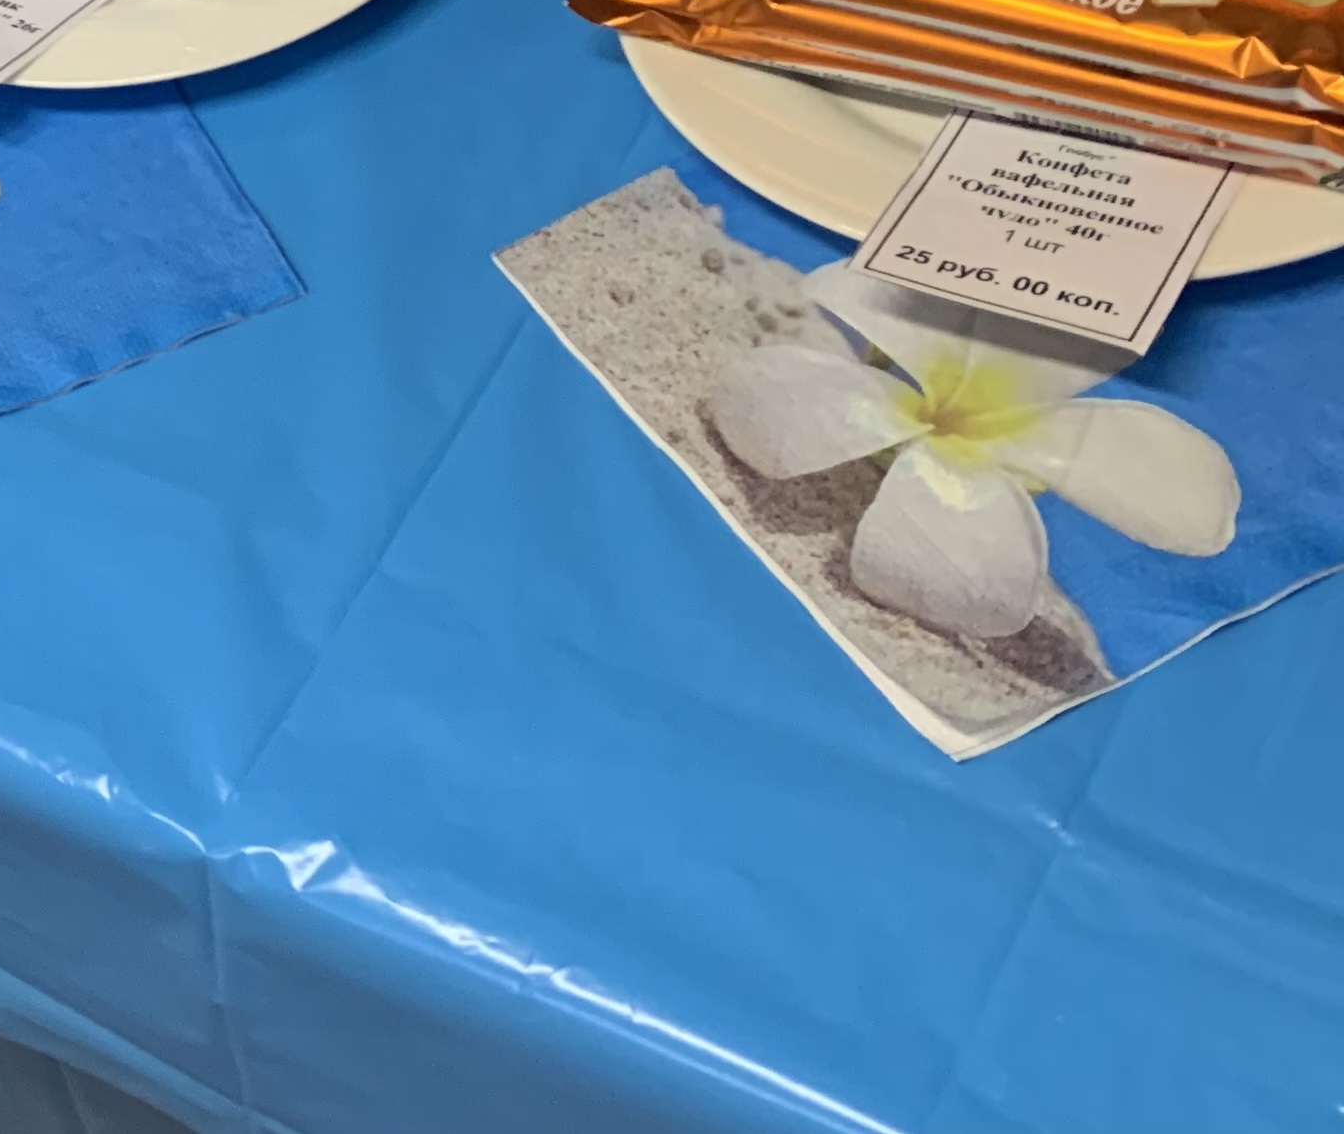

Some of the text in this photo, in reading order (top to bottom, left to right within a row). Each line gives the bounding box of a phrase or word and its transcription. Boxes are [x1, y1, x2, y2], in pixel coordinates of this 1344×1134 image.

[11, 19, 43, 35] 26г
[1016, 149, 1133, 186] Конфета
[948, 174, 1165, 236] "Обыкновенное
[989, 167, 1137, 208] вафельная
[981, 205, 1113, 243] чудо" 40г
[1004, 228, 1067, 255] 1 шт
[895, 244, 1122, 317] 25 руб. 00 коп.
